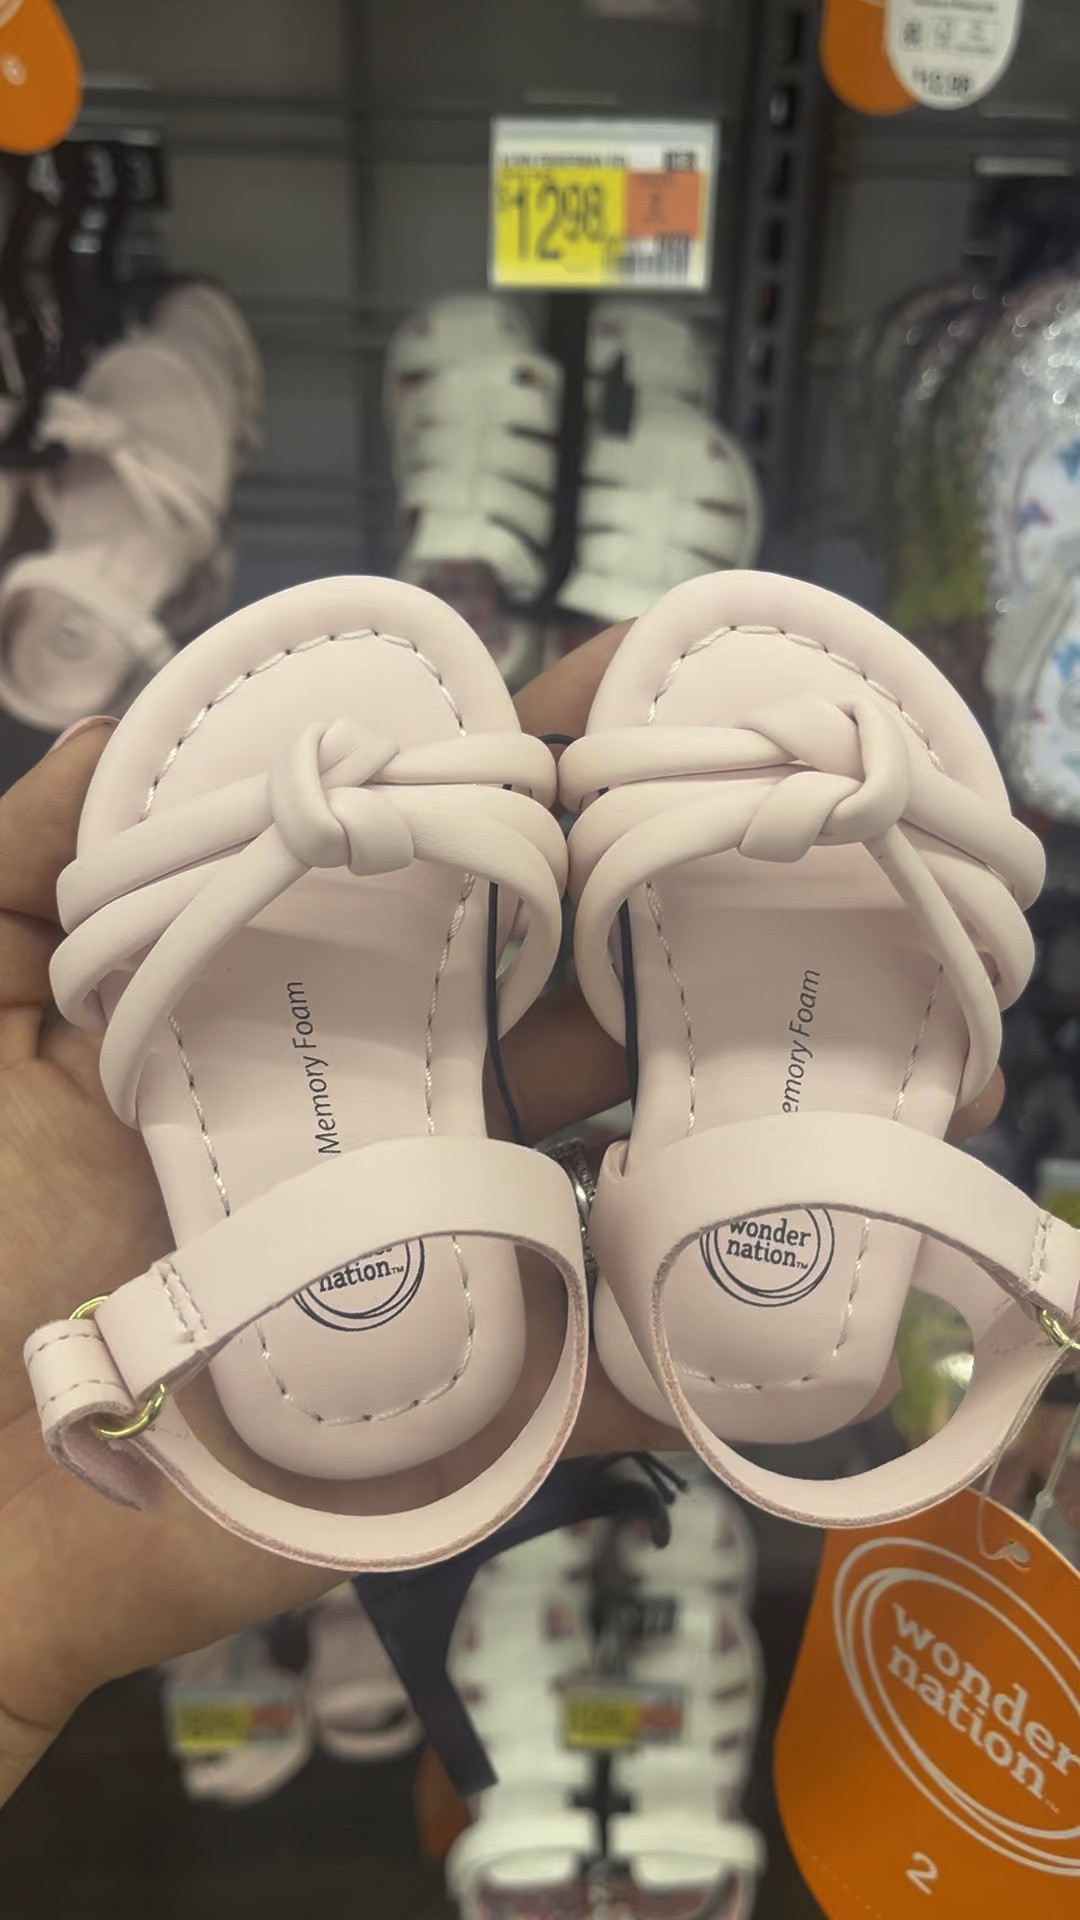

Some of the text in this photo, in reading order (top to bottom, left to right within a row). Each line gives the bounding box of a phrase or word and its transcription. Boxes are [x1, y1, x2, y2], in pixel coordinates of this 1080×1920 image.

[286, 981, 342, 1154] Memory Foam
[782, 968, 821, 1114] emory Foam
[729, 1217, 811, 1249] wonder
[892, 1601, 1080, 1777] wonder
[905, 1851, 939, 1895] 2
